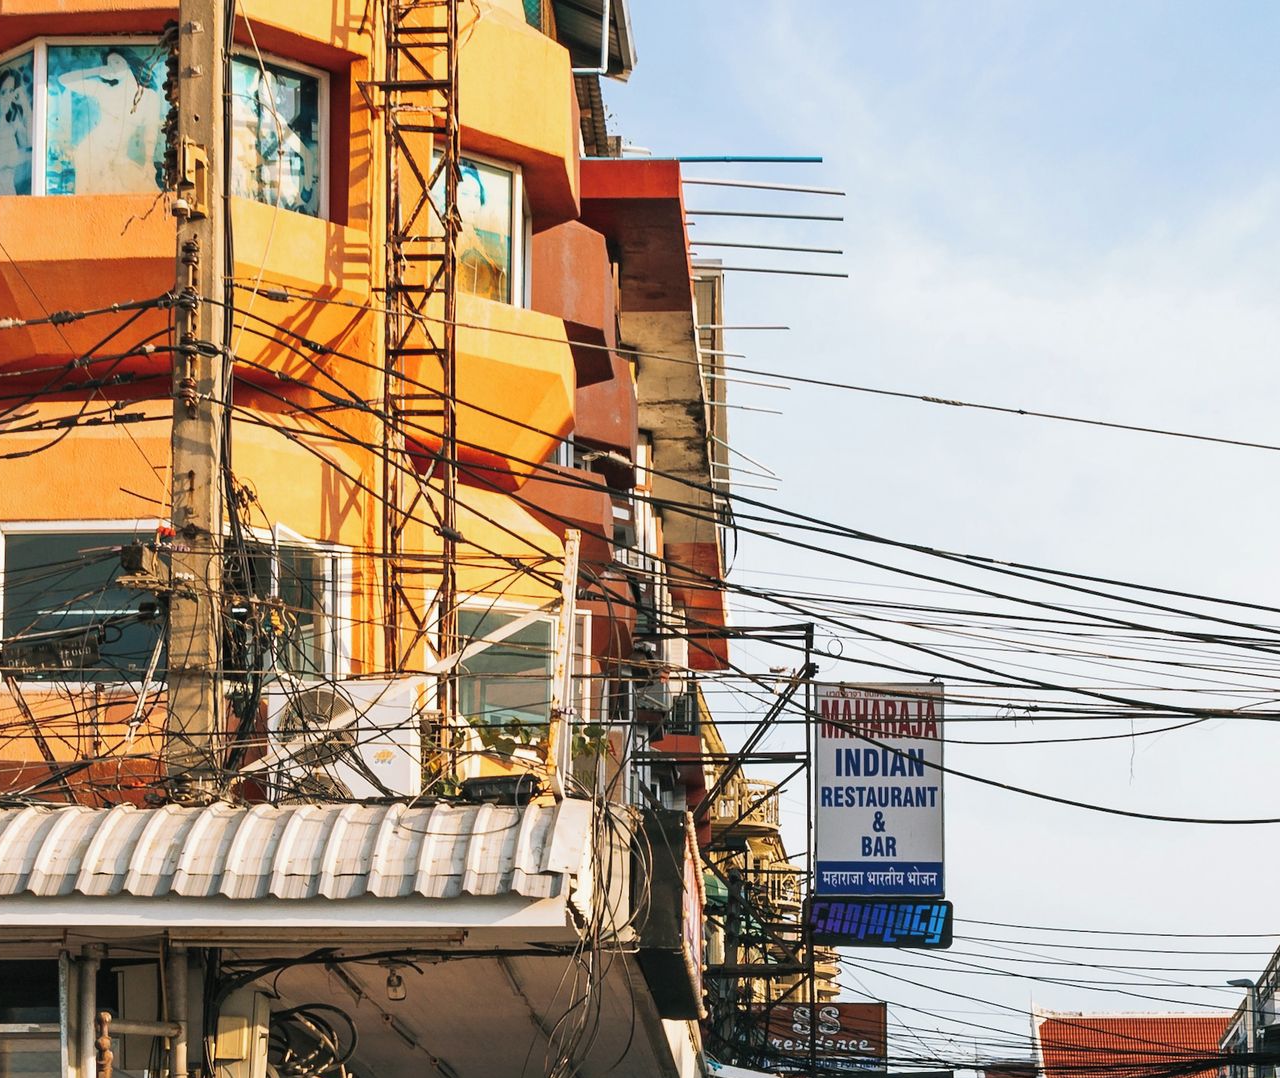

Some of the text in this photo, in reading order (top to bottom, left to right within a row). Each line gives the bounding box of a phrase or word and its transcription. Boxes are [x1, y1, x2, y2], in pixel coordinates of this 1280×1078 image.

[821, 698, 938, 739] MAHARAJA
[835, 748, 924, 777] INDIAN
[821, 786, 938, 808] RESTAURANT
[872, 811, 886, 833] &
[861, 836, 897, 857] BAR
[822, 866, 937, 887] महाराजा भारतीय भोजन
